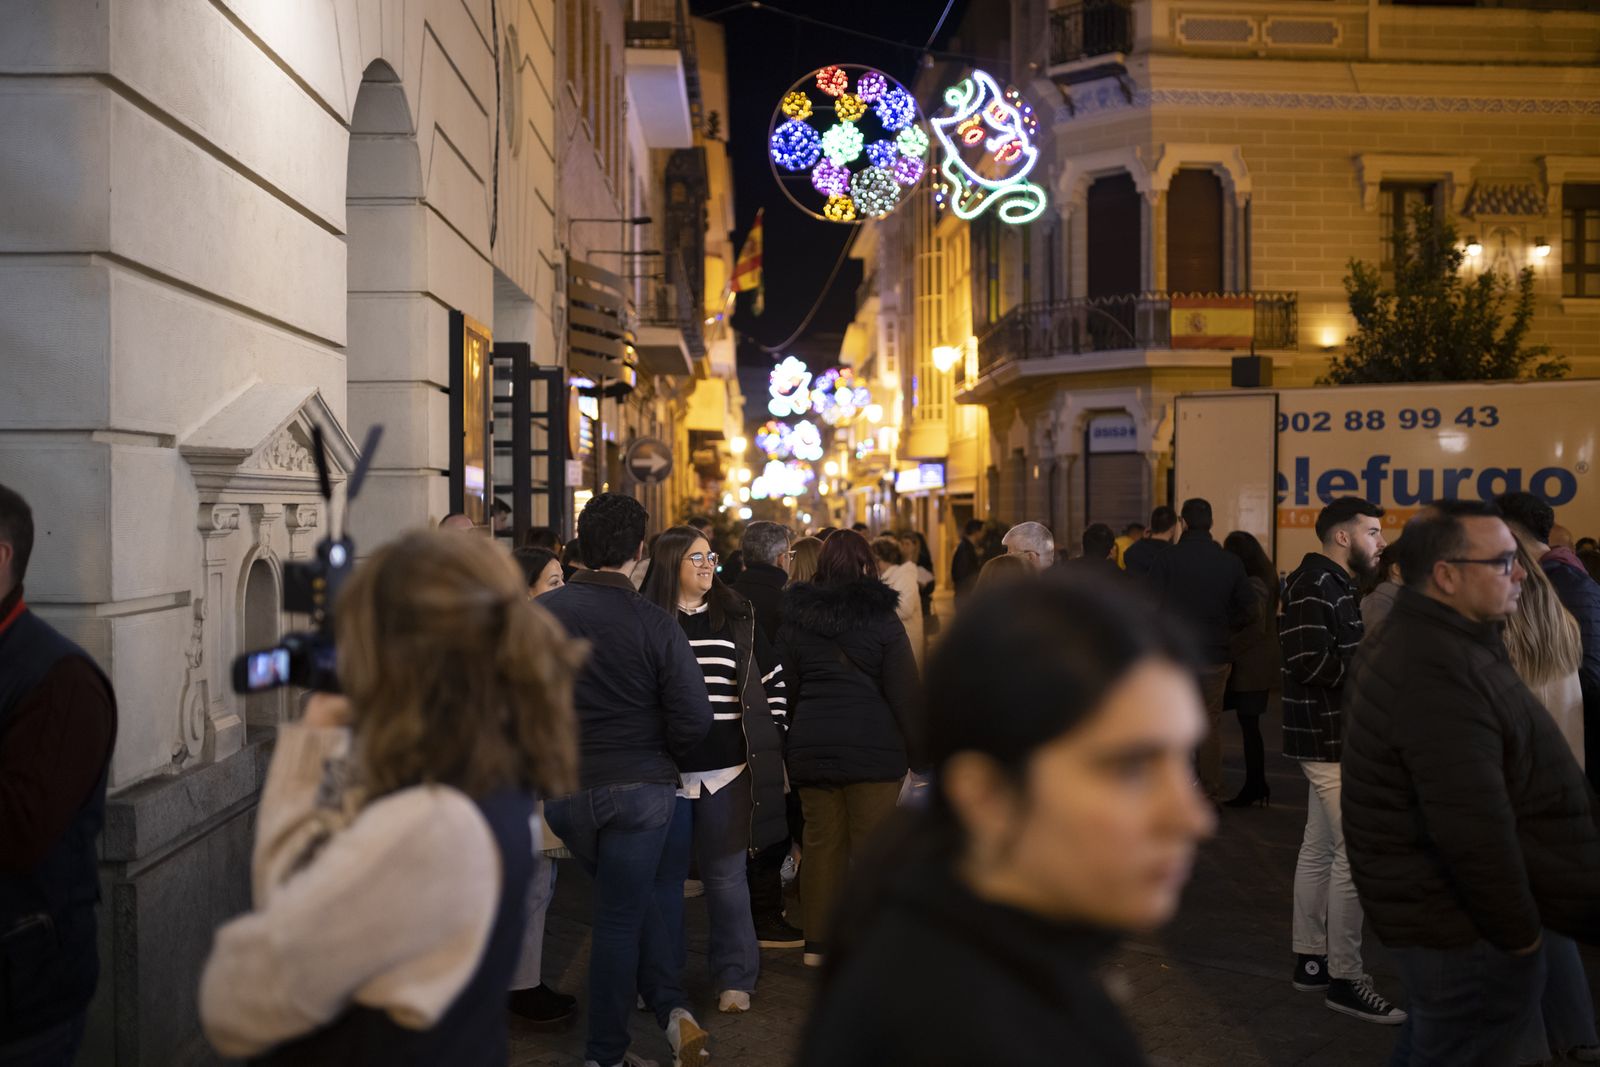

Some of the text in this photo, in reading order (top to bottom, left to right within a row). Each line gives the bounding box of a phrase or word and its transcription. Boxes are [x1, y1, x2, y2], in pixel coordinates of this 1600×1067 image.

[1278, 406, 1500, 432] 902 88 99 43
[1277, 454, 1577, 508] lefurgo
